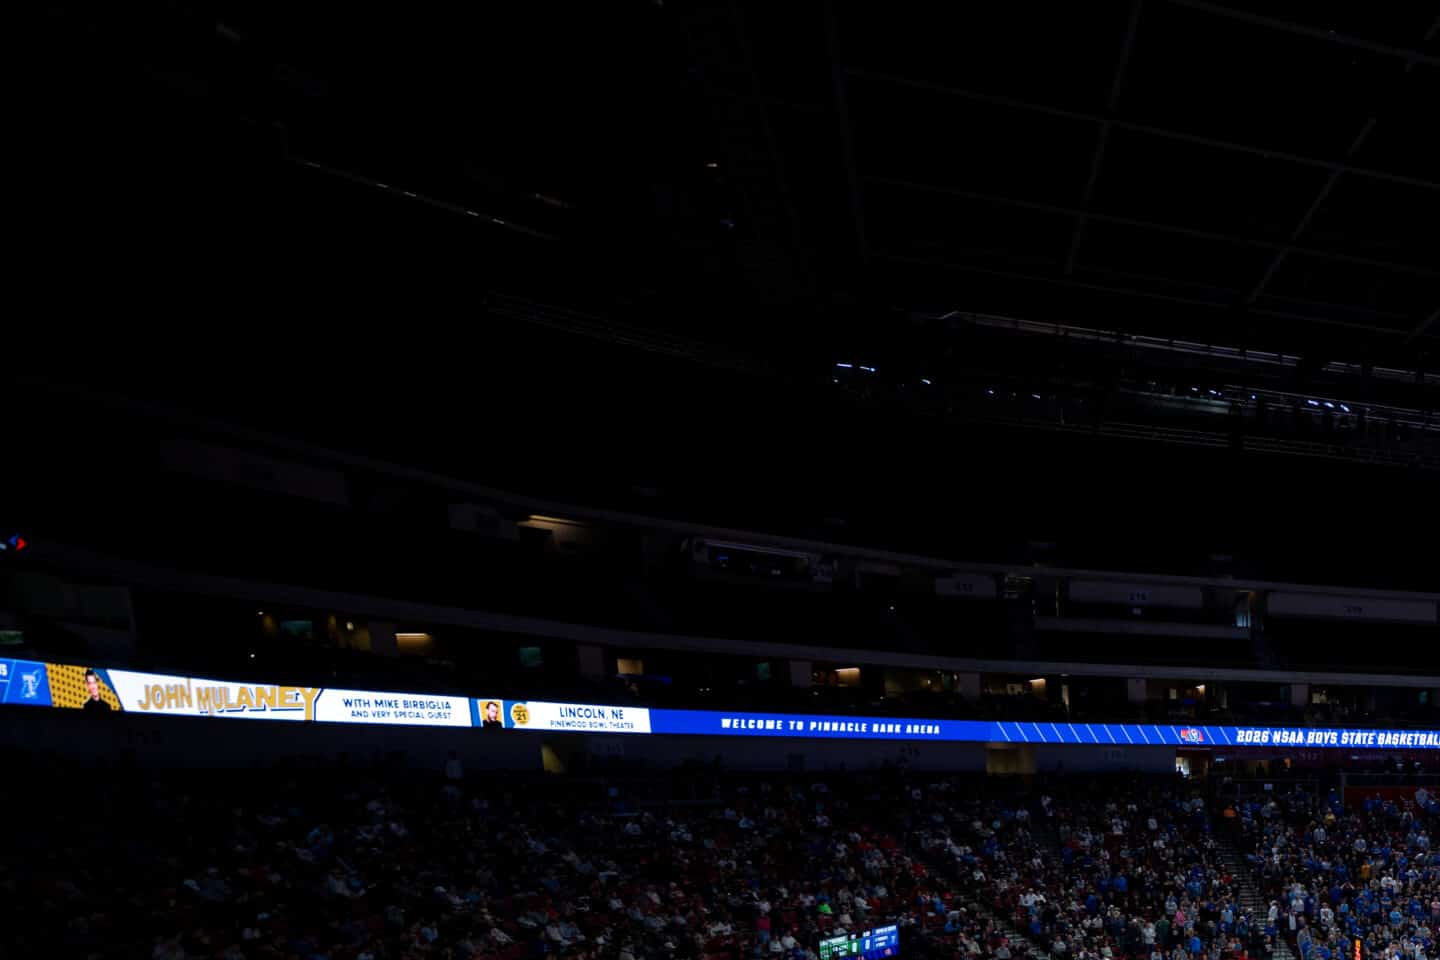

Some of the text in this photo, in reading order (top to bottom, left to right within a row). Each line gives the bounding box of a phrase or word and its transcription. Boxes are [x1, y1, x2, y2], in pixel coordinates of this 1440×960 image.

[137, 678, 319, 721] JOHN MULANEY
[343, 698, 452, 709] WITH MIKE BIRBIGLIA
[351, 710, 369, 718] AND
[611, 709, 624, 720] NE
[721, 718, 940, 734] WELCOME TO PINNACLE BANK ARENA
[1237, 730, 1269, 743] 2026
[1272, 730, 1303, 743] NSAA
[1307, 731, 1338, 744] BOYS
[1341, 732, 1374, 745] STATE
